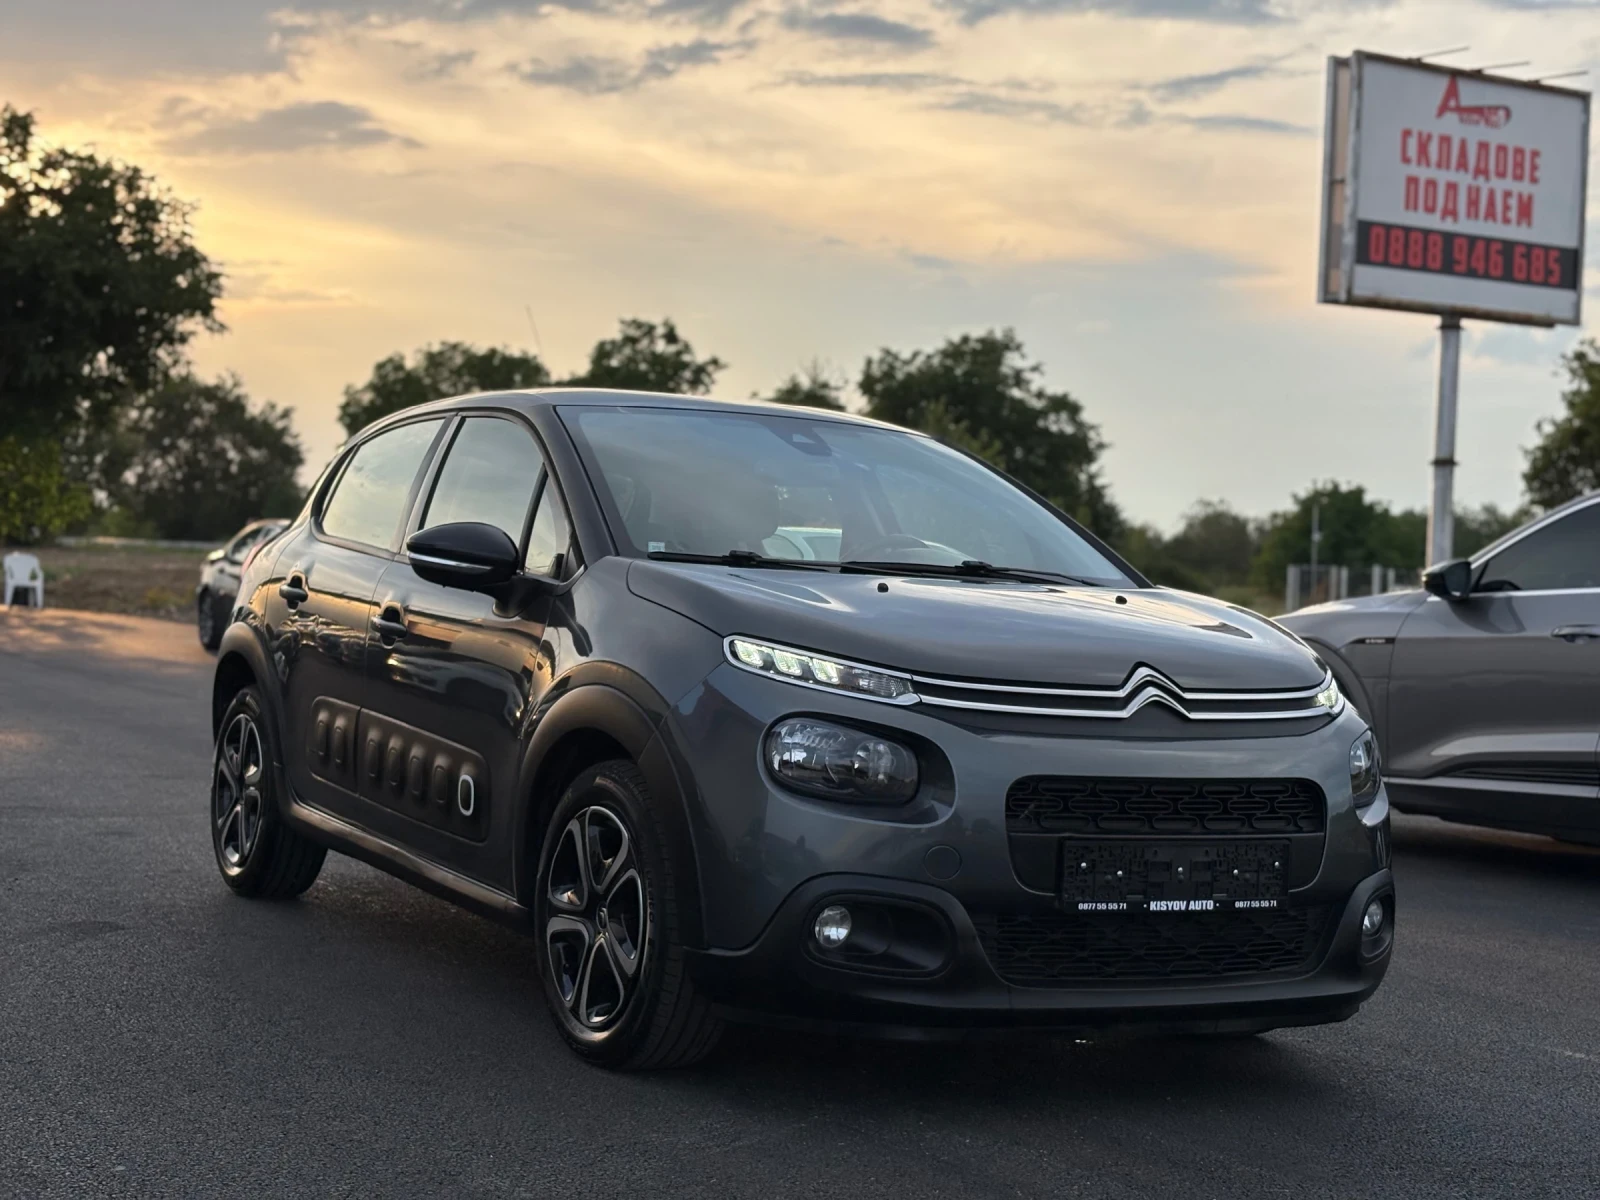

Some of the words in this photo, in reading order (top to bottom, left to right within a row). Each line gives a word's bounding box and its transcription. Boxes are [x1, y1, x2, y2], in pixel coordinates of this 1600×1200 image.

[1400, 128, 1542, 184] СКЛАДОВЕ
[1404, 174, 1460, 224] ПОД
[1465, 183, 1535, 228] НАЕМ
[1368, 224, 1443, 271] 0888
[1452, 236, 1504, 277] 946
[1512, 243, 1561, 285] 685
[1078, 902, 1096, 910] 0877
[1096, 902, 1107, 910] 55
[1108, 902, 1118, 910] 55
[1119, 902, 1127, 910] 71
[1149, 900, 1187, 911] KISYOV
[1188, 899, 1214, 911] AUTO
